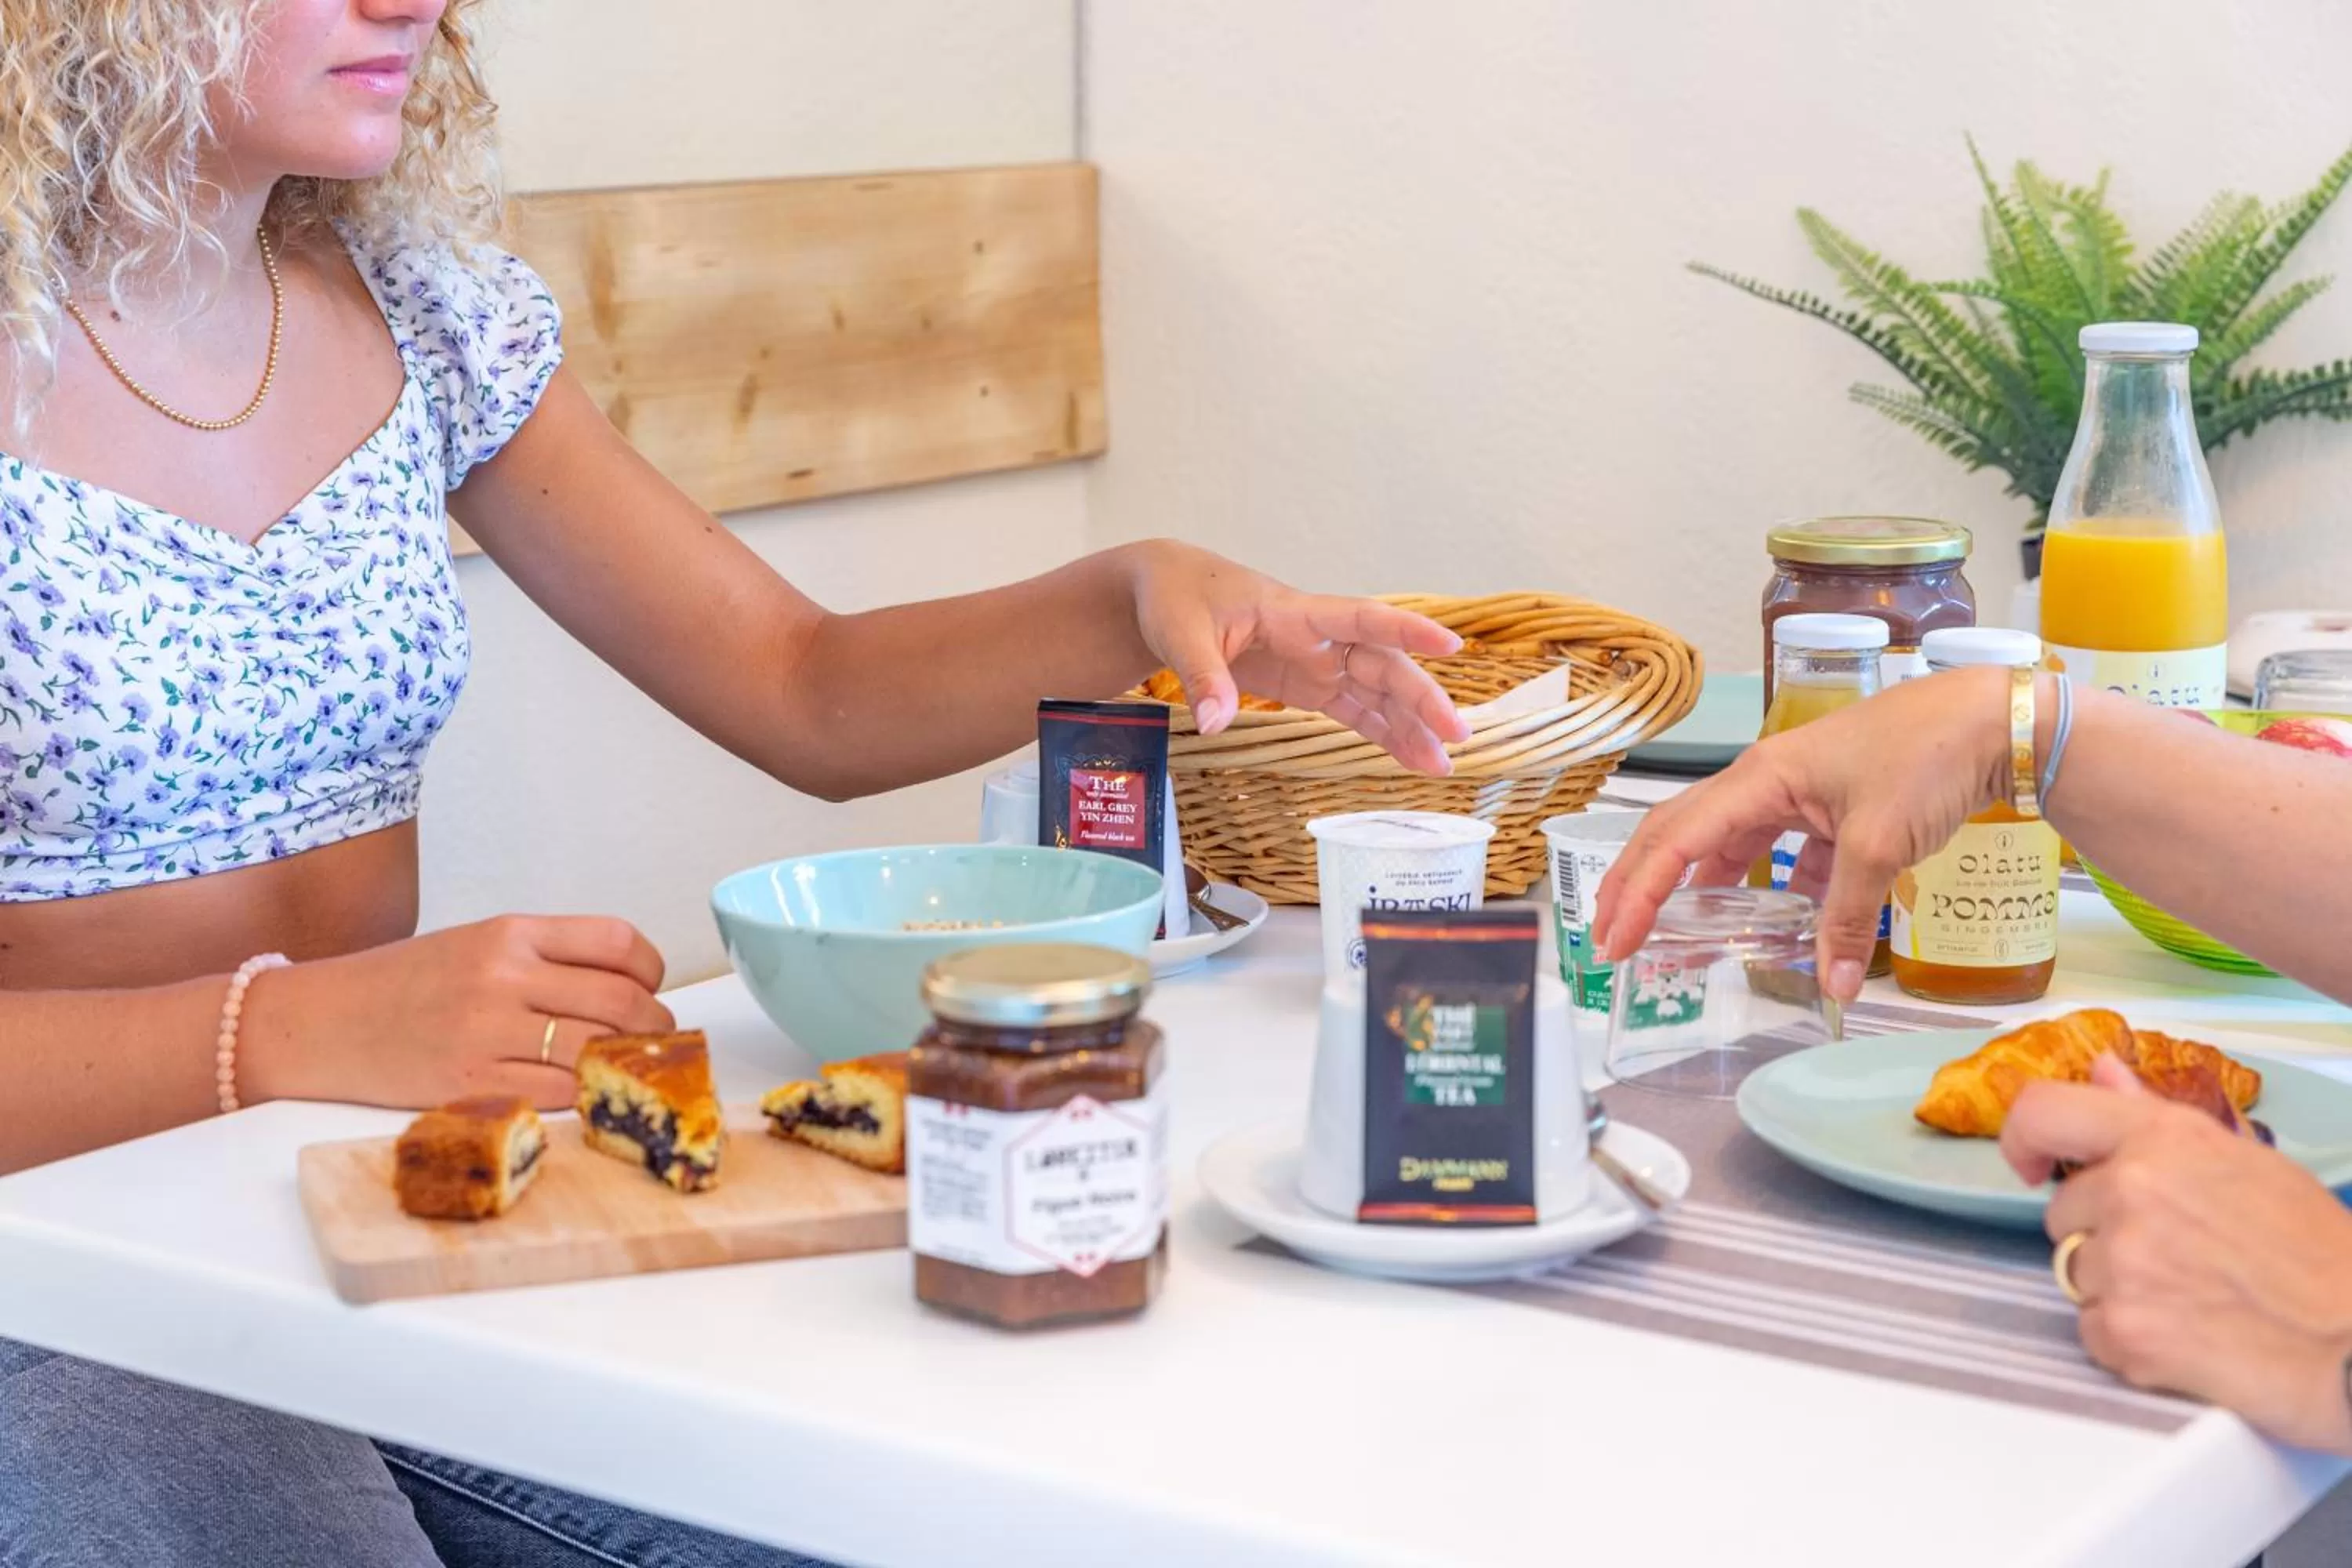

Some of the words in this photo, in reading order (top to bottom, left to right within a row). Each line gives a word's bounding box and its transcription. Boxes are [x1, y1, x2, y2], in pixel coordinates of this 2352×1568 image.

[1078, 800, 1106, 811] EARL
[1107, 802, 1138, 813] GREY
[1080, 811, 1101, 822] YIN
[1102, 813, 1135, 825] ZHEN
[1959, 853, 2042, 874] Olatu
